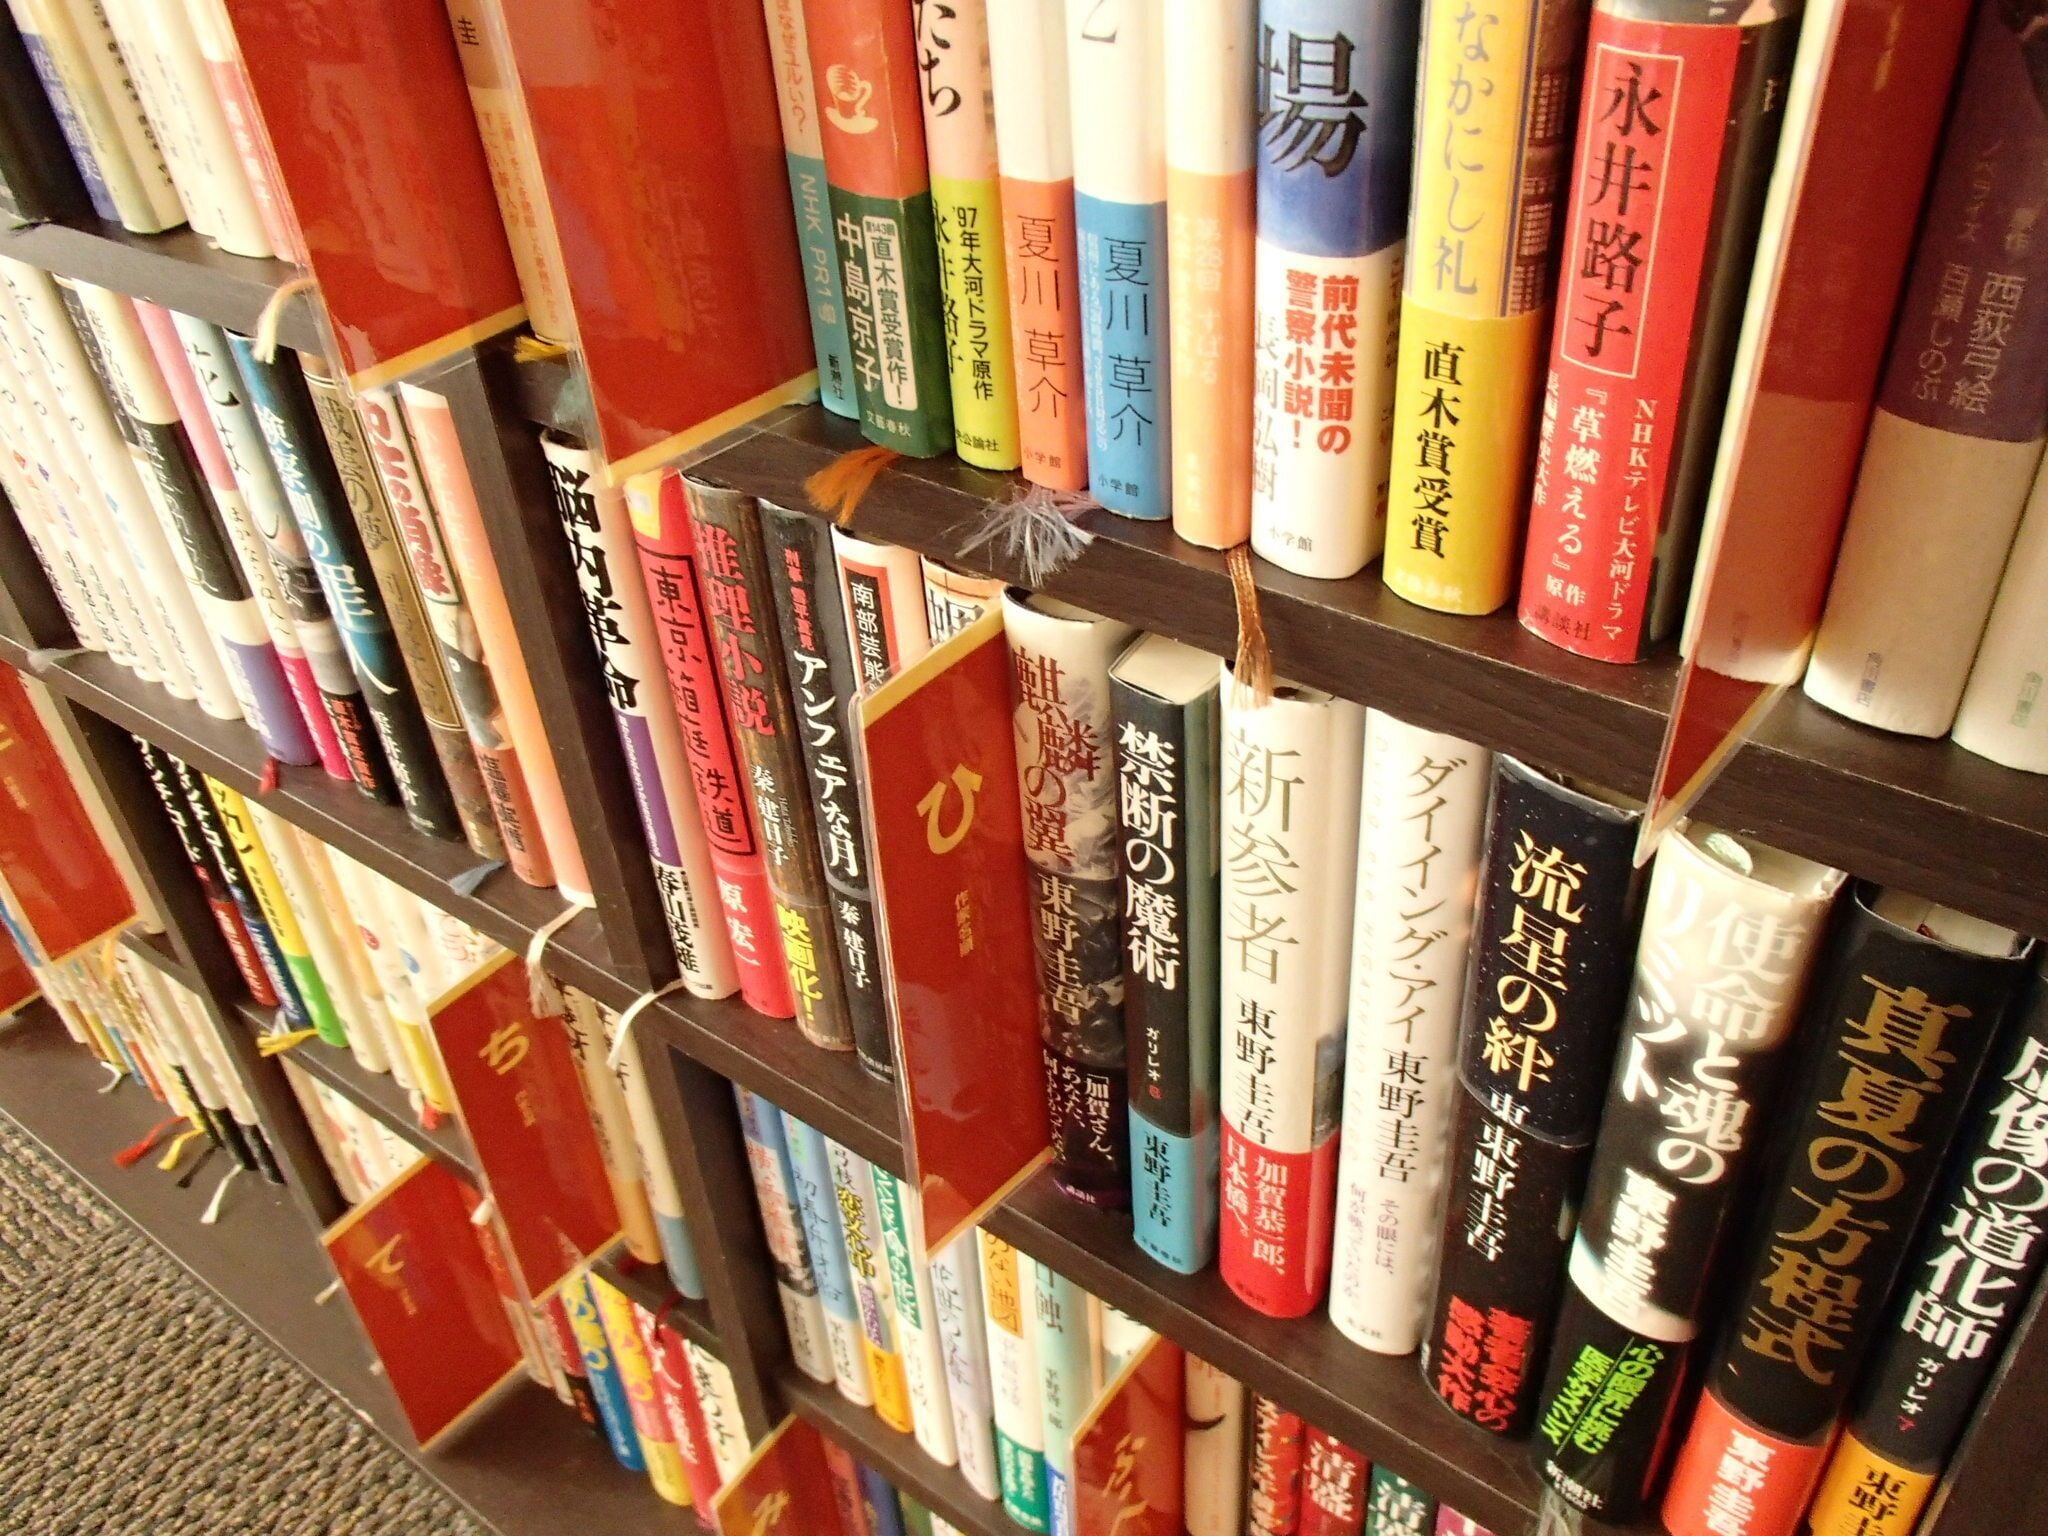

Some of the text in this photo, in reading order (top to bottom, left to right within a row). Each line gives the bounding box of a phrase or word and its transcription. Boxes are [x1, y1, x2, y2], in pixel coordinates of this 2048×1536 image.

[1258, 24, 1368, 179] 場
[1434, 1, 1499, 297] なかにし礼
[799, 174, 823, 234] NHK
[1574, 61, 1663, 358] 永井路子
[836, 213, 881, 393] 中島京子
[1016, 214, 1067, 419] 夏川草介
[1104, 236, 1154, 447] 夏川草介
[1318, 275, 1360, 456] 前代未聞の
[1949, 270, 2027, 416] 西荻弓絵
[1098, 475, 1140, 498] 小学館
[1410, 341, 1466, 559] 直木賞受賞
[693, 518, 776, 737] 推理小説
[850, 581, 886, 692] 南部芸能
[752, 765, 790, 866] 秦建日子
[794, 649, 860, 878] アンフェアな月
[916, 763, 983, 854] ひ
[1013, 645, 1101, 869] 麒麟の翼
[655, 865, 700, 974] 春山茂雄
[1118, 719, 1181, 991] 禁断の魔術
[1226, 726, 1306, 985] 新参者
[1387, 755, 1468, 1044] ダイイング・アイ
[838, 900, 872, 989] 秦建日子
[1039, 873, 1086, 1025] 東野圭吾
[1483, 829, 1588, 1091] 流星の絆
[479, 1022, 530, 1075] ち
[1145, 1026, 1163, 1082] ガリレオ
[1236, 992, 1277, 1145] 東野圭吾
[1377, 1047, 1430, 1183] 東野圭吾
[1656, 901, 1806, 1184] 使命と魂の
[1143, 1131, 1172, 1228] 東野圭吾
[1465, 1126, 1523, 1262] 東野圭吾
[1603, 1168, 1677, 1322] 東野圭吾
[1741, 974, 1972, 1386] 真夏の方程式
[1899, 1356, 1943, 1415] ガリレオ
